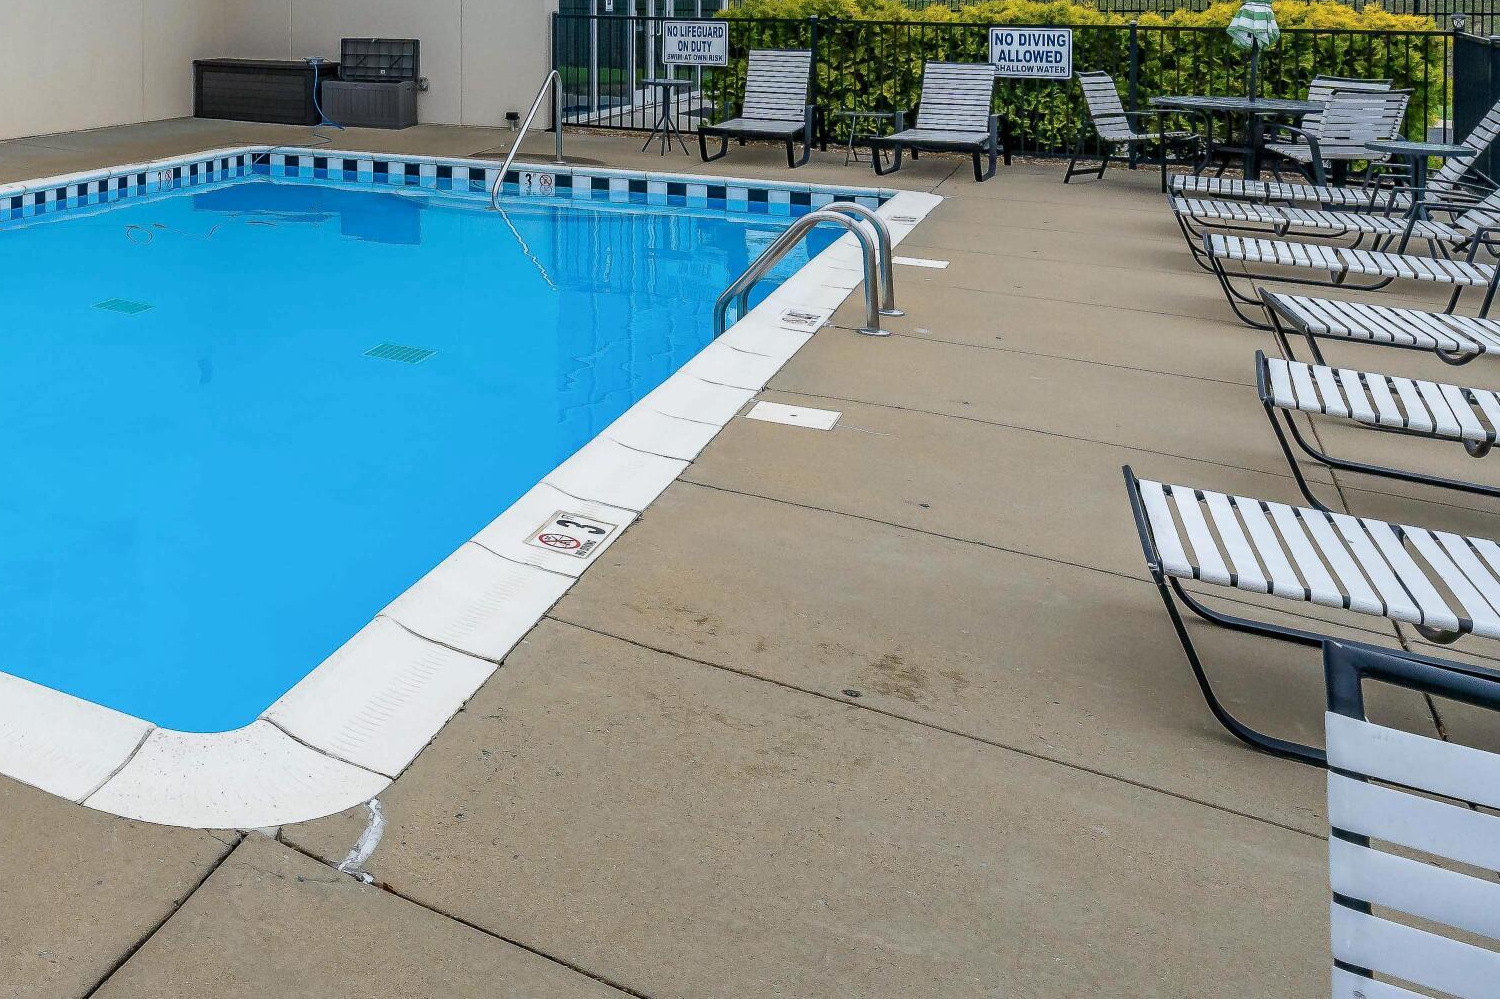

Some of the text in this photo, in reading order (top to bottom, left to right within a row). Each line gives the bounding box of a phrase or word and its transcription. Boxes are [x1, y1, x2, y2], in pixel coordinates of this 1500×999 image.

[667, 26, 724, 38] NO LIFEGUARD
[677, 40, 712, 52] ON DUTY
[994, 33, 1066, 47] NO DIVING
[998, 49, 1063, 63] ALLOWED
[995, 64, 1066, 74] SHALLOW WATER
